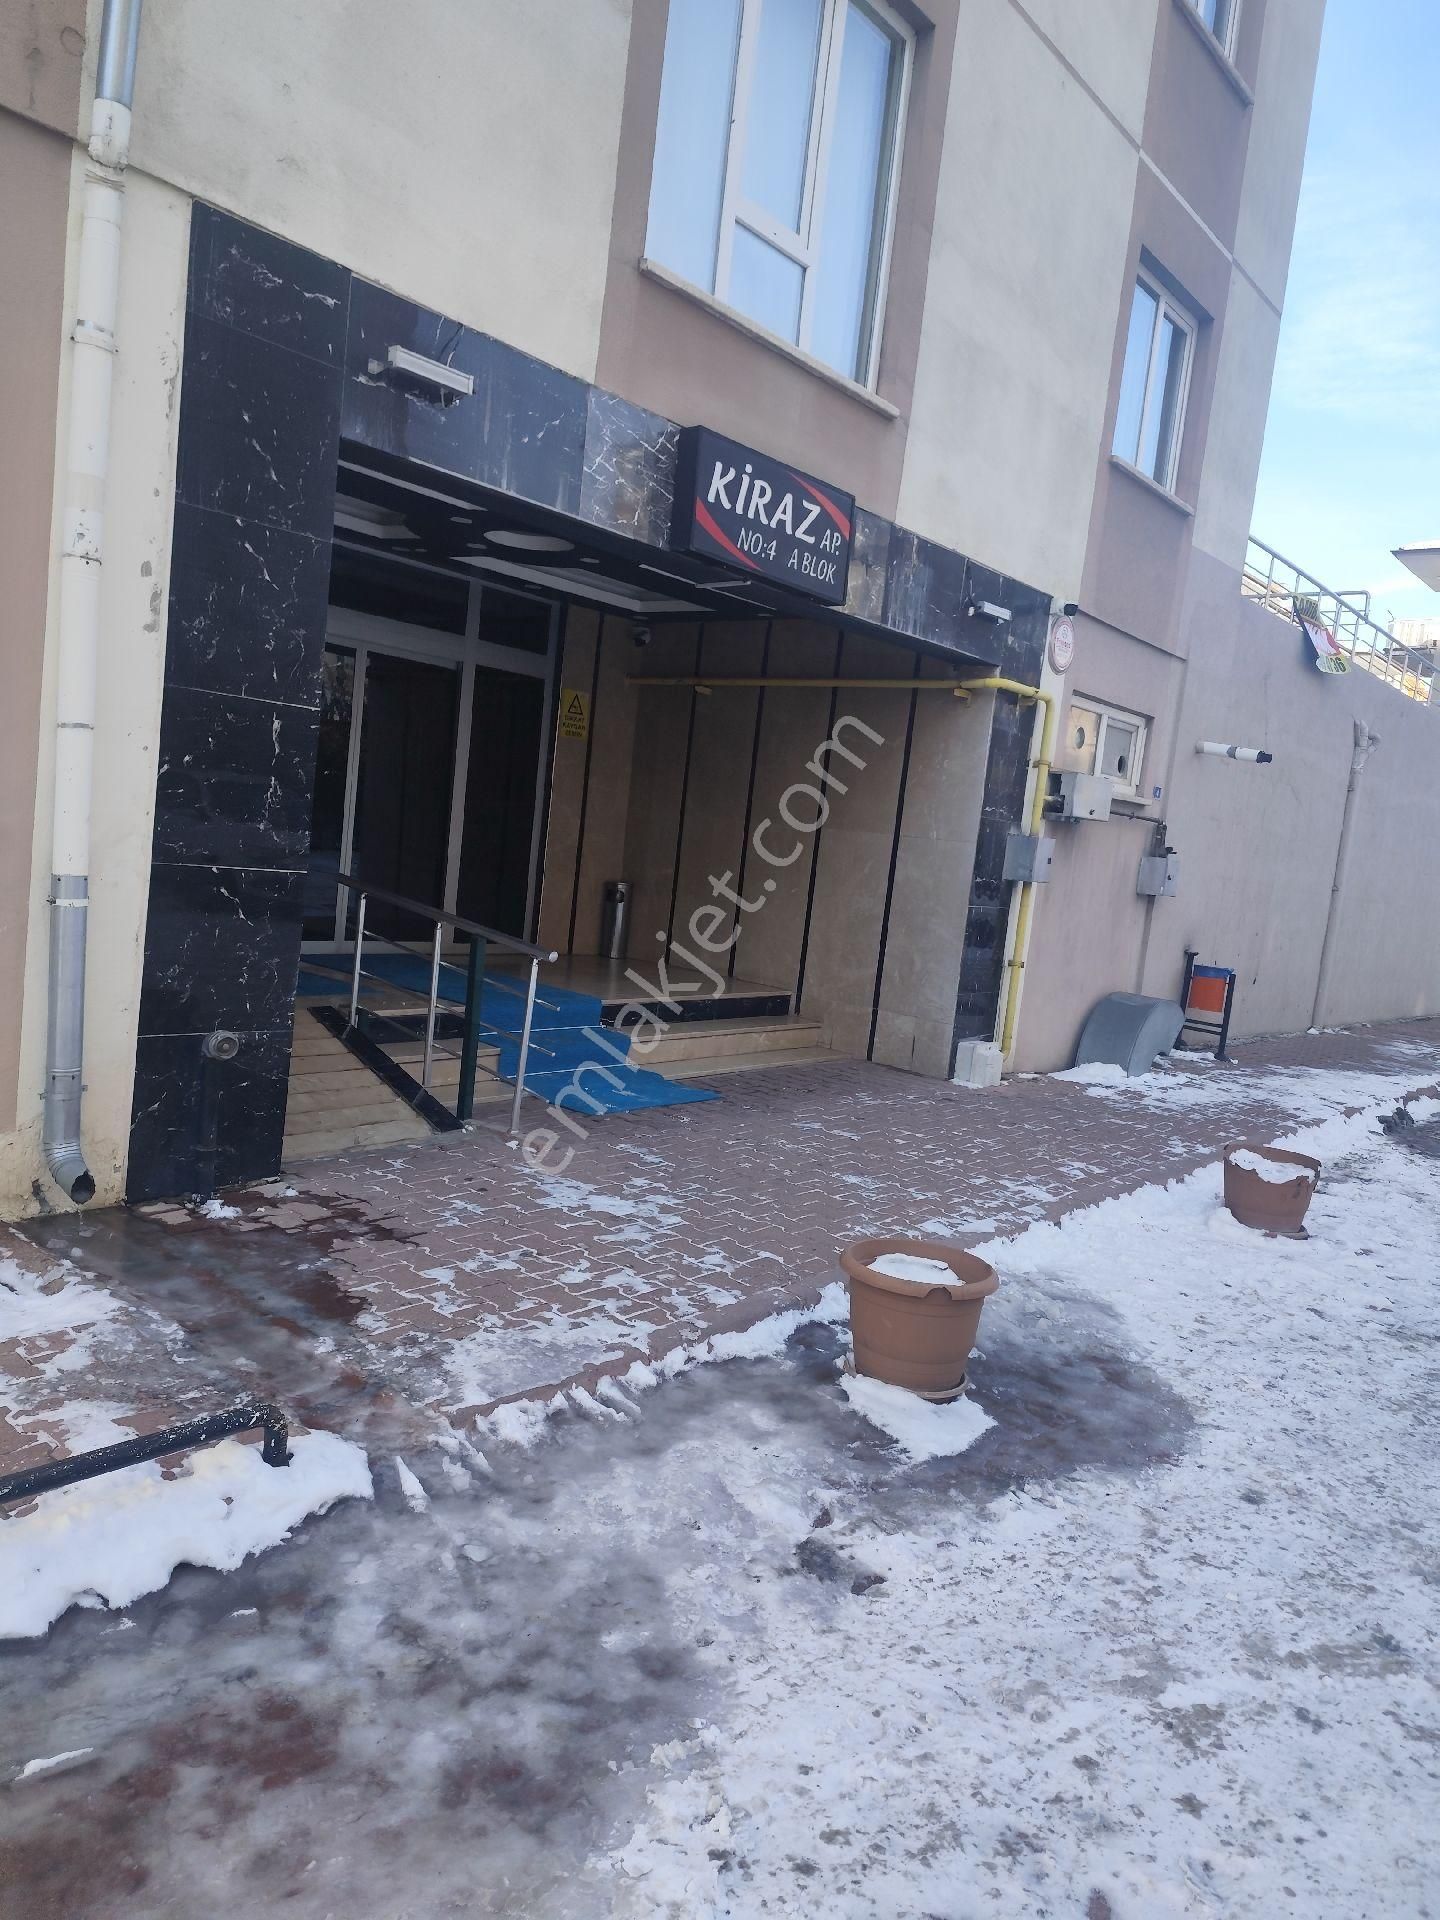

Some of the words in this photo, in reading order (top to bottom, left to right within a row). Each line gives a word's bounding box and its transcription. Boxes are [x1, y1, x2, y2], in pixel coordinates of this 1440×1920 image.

[707, 461, 821, 544] KİRAZ
[820, 529, 842, 556] AP.
[737, 527, 777, 561] NO:4
[787, 548, 799, 570] A
[801, 552, 837, 585] BLOK
